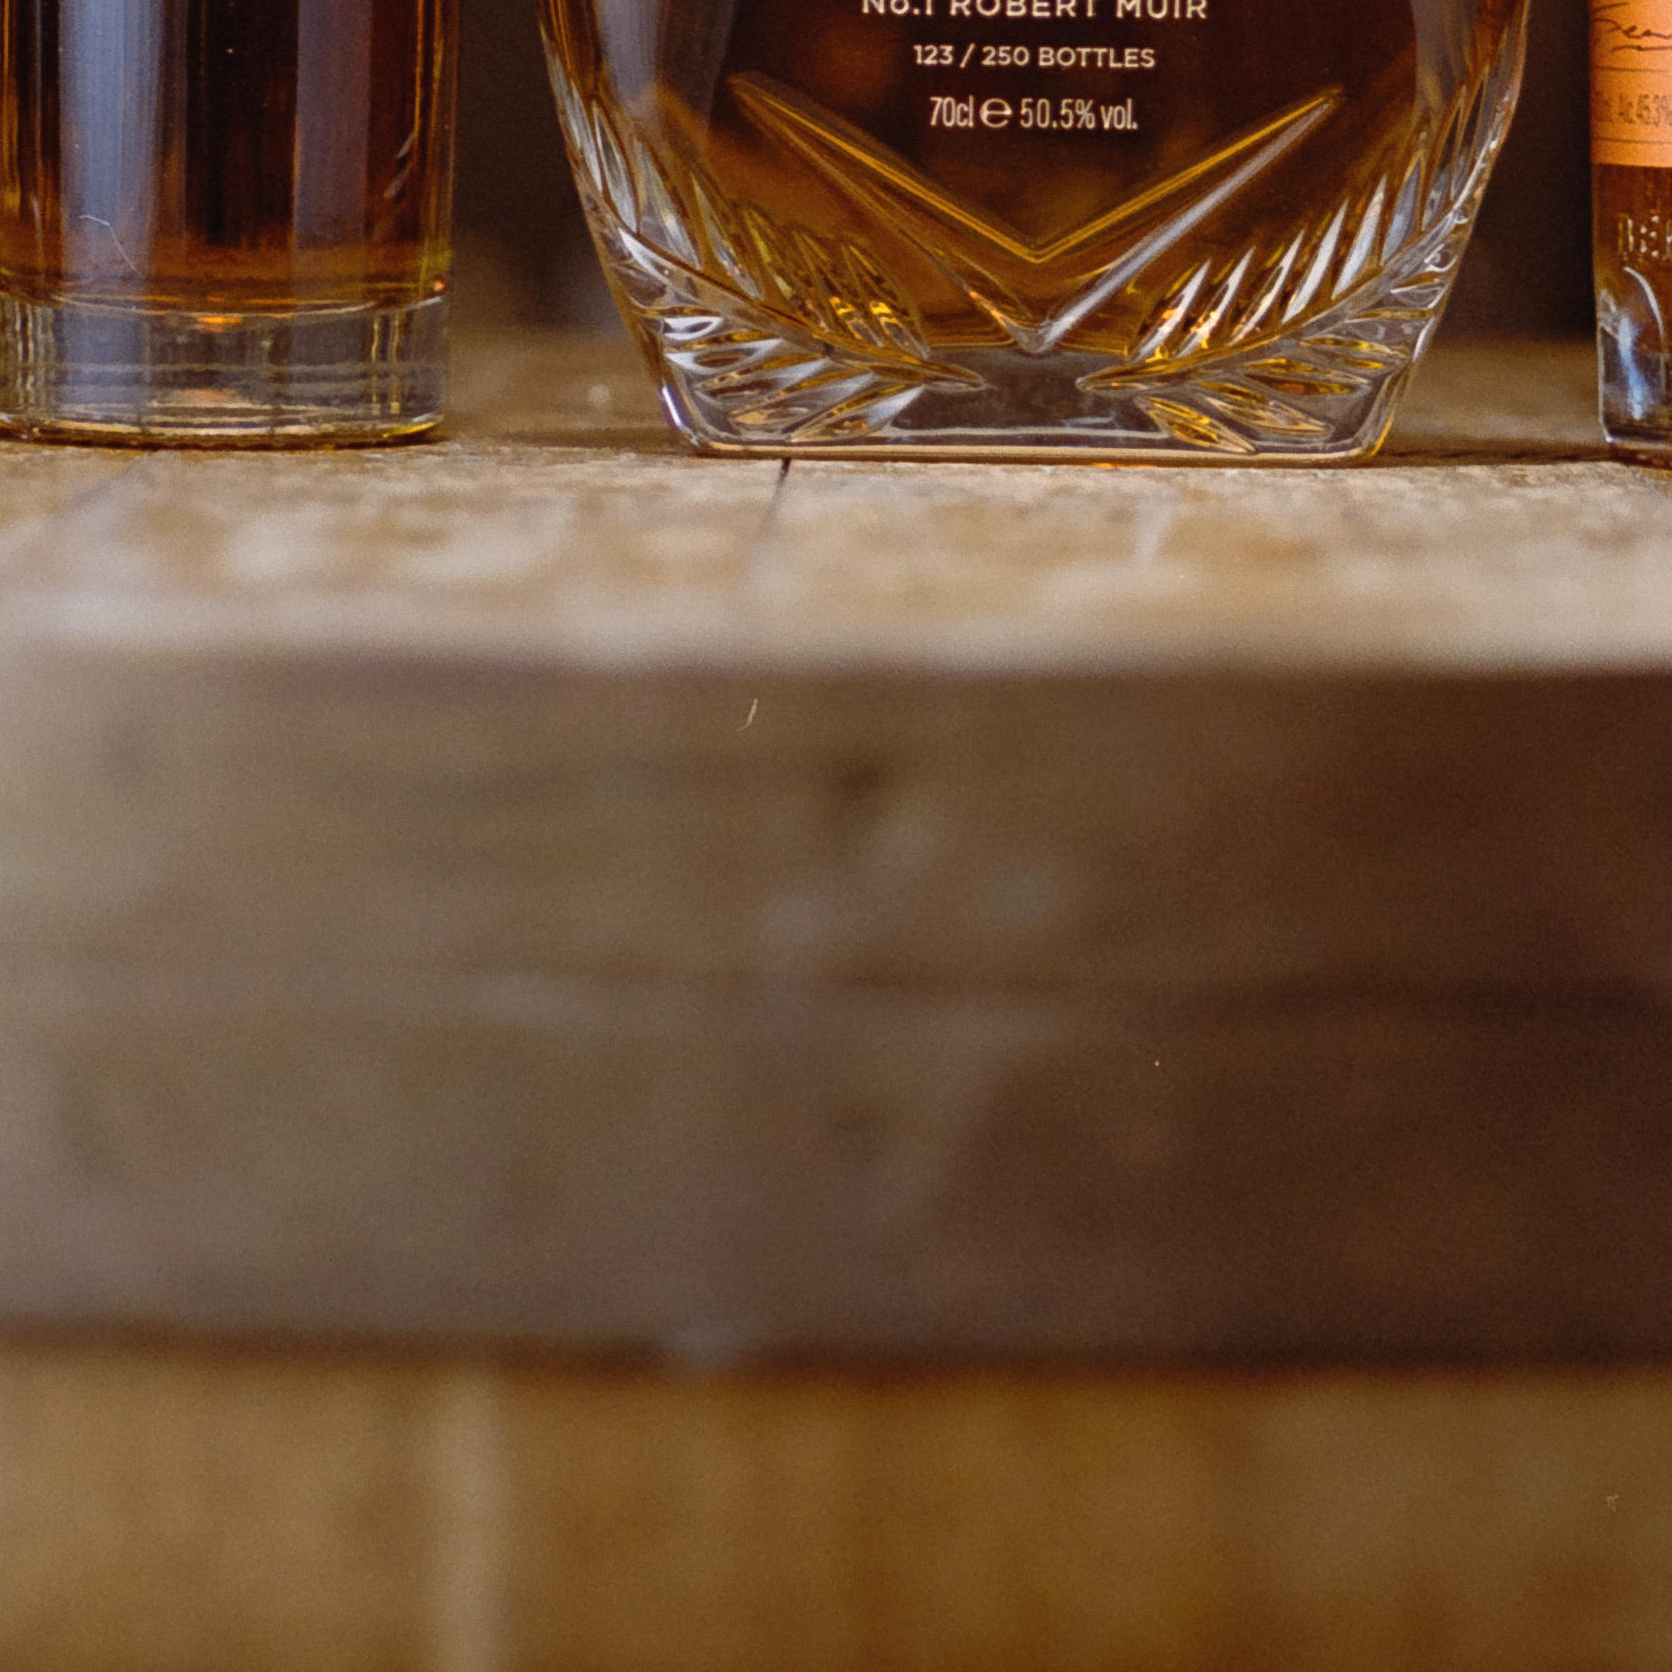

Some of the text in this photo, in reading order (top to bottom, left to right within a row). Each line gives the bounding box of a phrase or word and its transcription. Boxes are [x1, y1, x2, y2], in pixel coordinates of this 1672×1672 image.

[913, 44, 953, 66] 123
[982, 45, 1030, 66] 250
[1037, 47, 1155, 68] BOTTLES
[929, 96, 974, 127] 70cl
[1019, 98, 1095, 128] 50.5%
[1100, 98, 1138, 129] vol.
